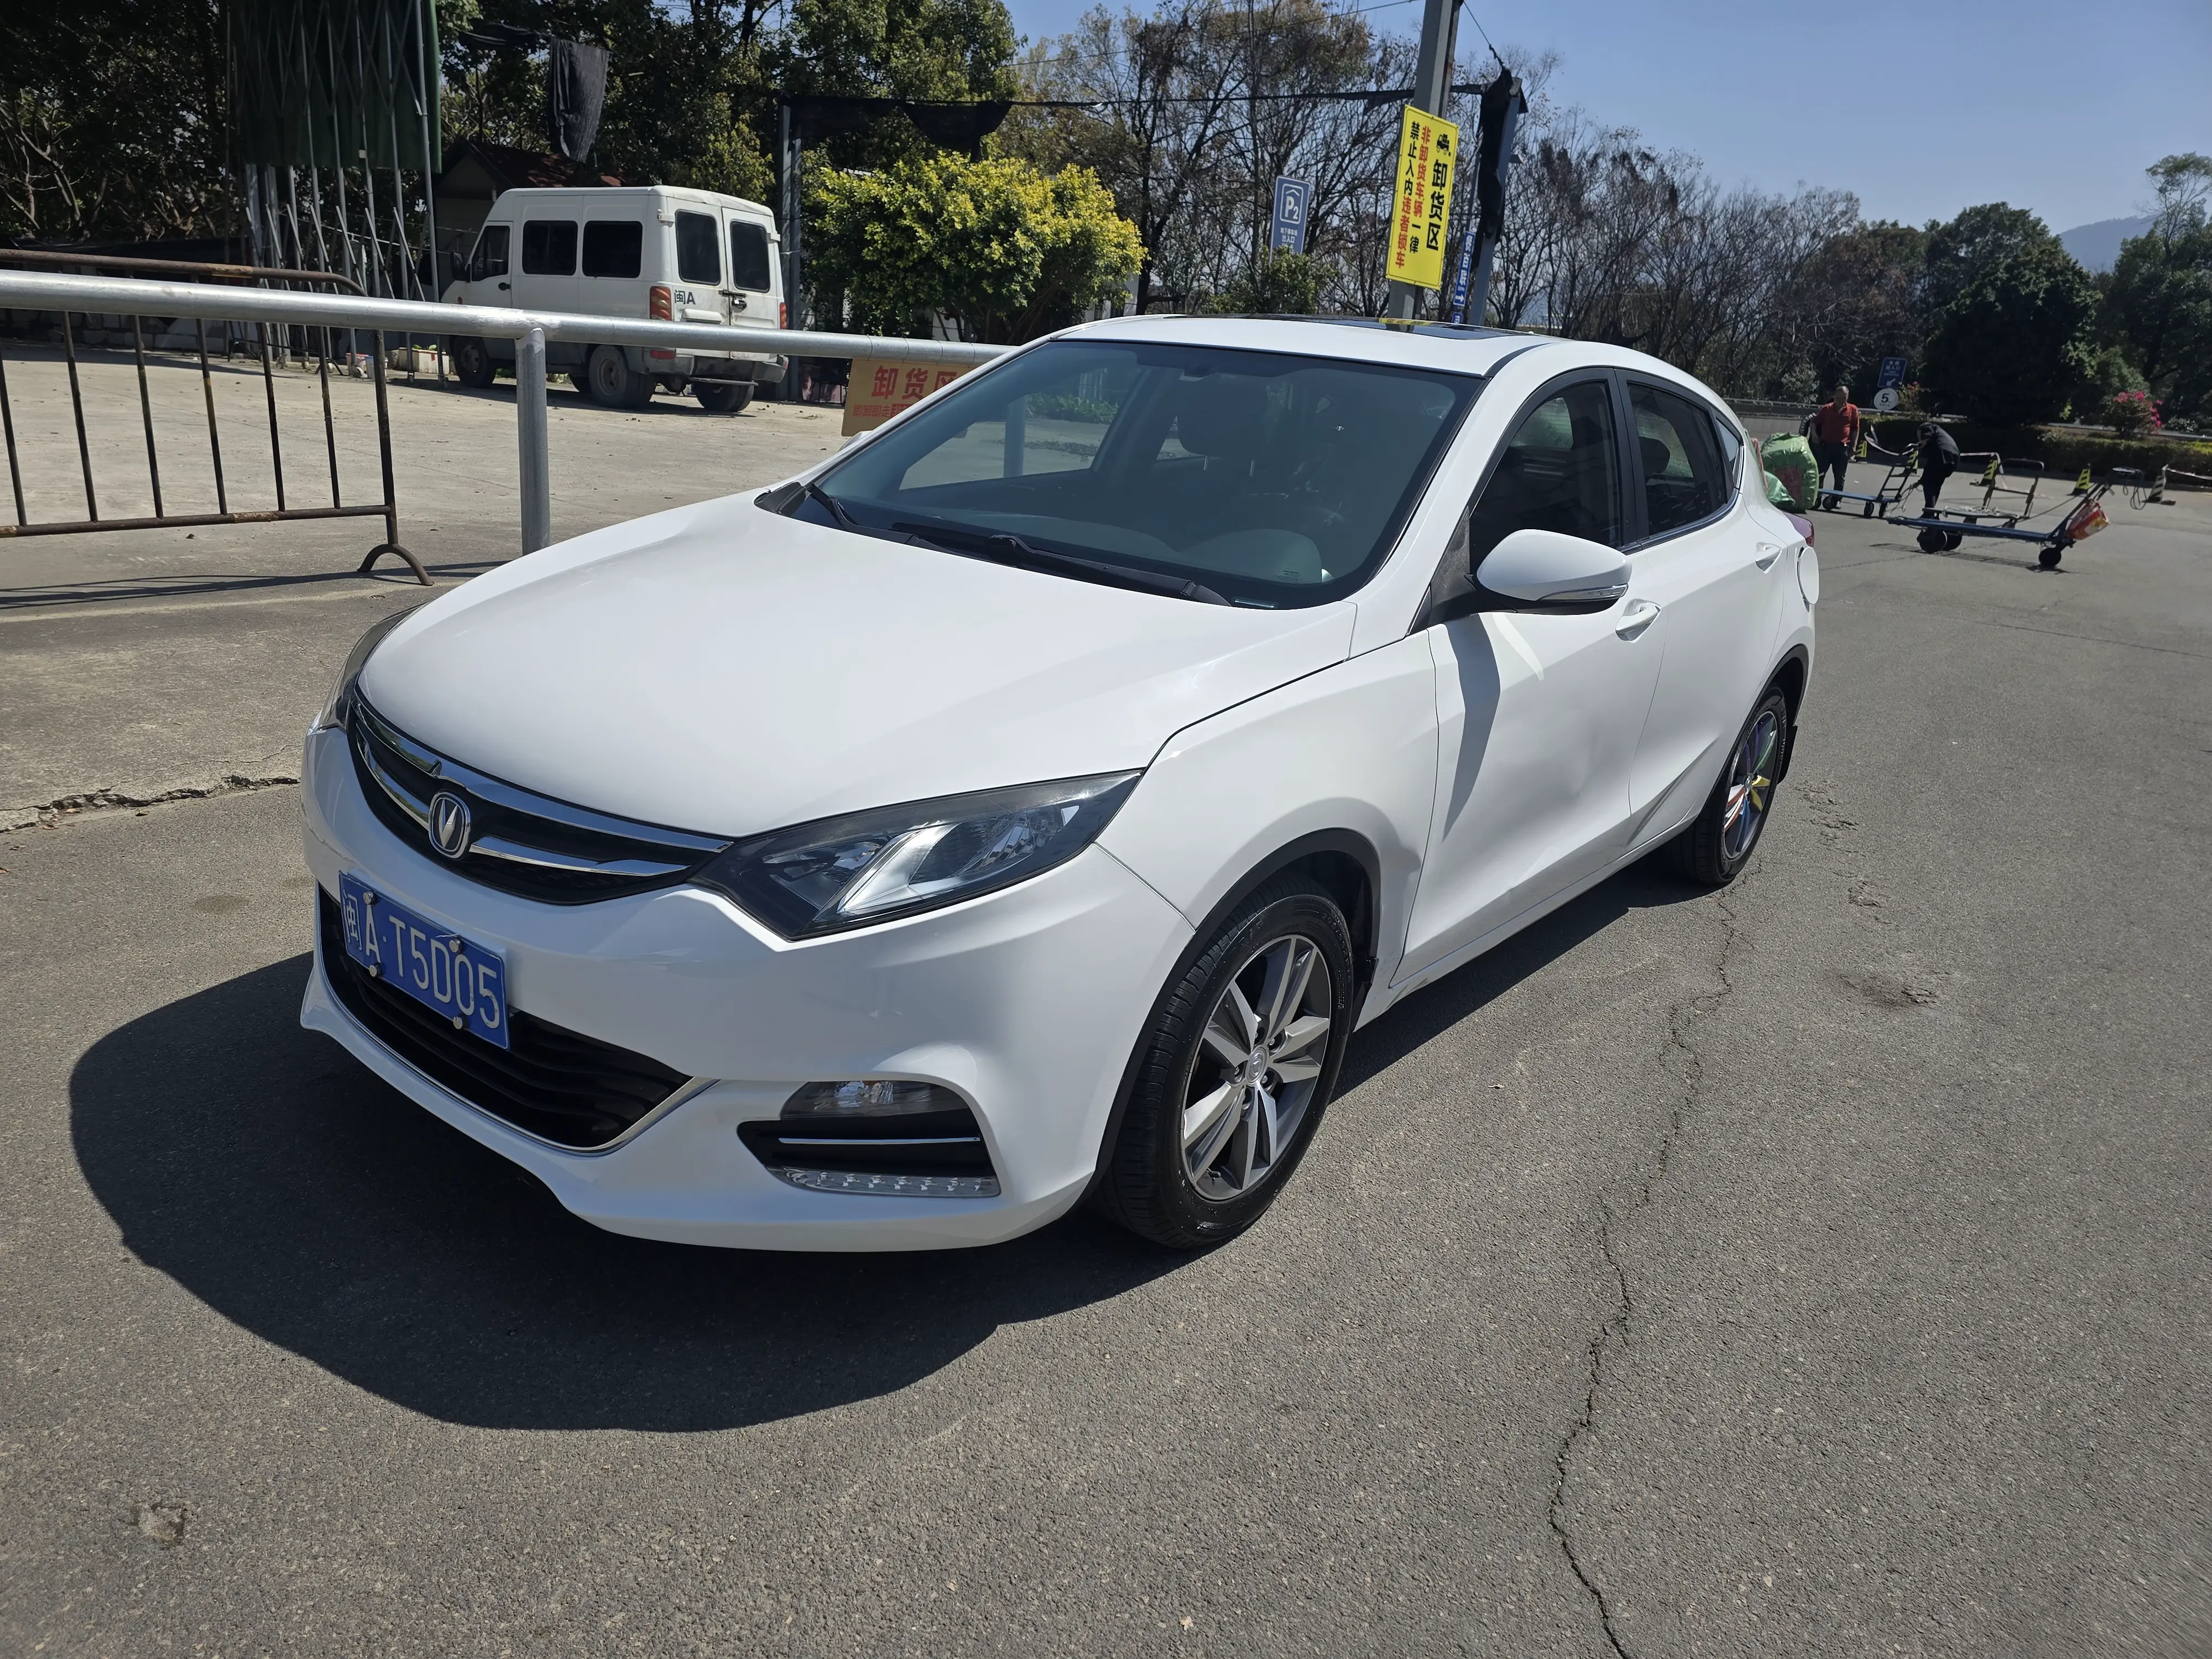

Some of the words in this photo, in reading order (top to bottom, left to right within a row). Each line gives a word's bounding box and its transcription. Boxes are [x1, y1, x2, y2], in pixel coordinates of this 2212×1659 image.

[1426, 159, 1448, 251] 卸货区
[674, 290, 696, 305] 闽A
[1881, 393, 1890, 403] 5
